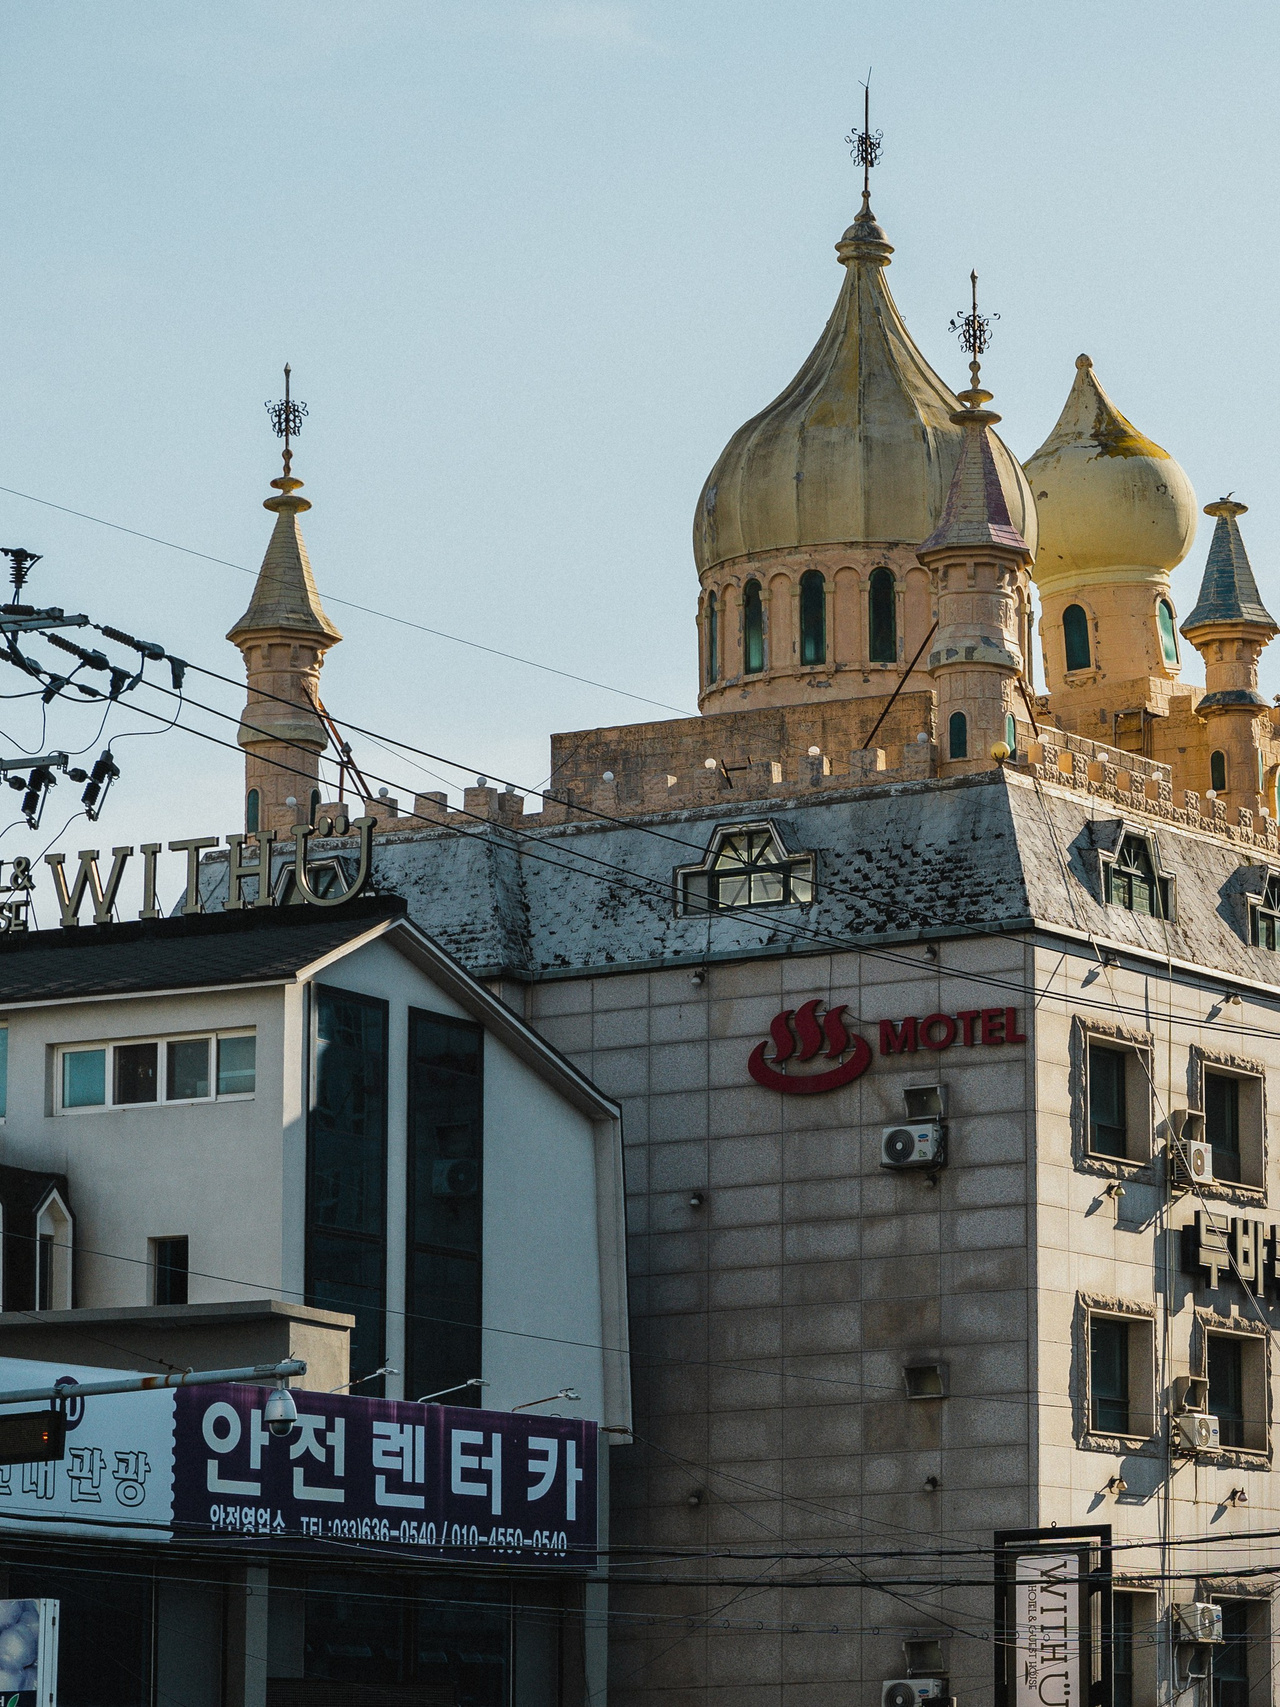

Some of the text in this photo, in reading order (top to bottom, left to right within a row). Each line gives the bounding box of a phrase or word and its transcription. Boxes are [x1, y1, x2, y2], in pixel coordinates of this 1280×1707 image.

[10, 856, 36, 891] &
[44, 815, 377, 926] WITHÜ
[880, 1007, 1027, 1055] MOTEL
[202, 1400, 583, 1521] 안전렌터카
[209, 1504, 286, 1535] 안전영업소
[451, 1524, 567, 1557] 010-4550-0540
[1027, 1585, 1037, 1615] HOTEL
[1028, 1615, 1037, 1623] &
[1039, 1560, 1070, 1707] WITHÜ
